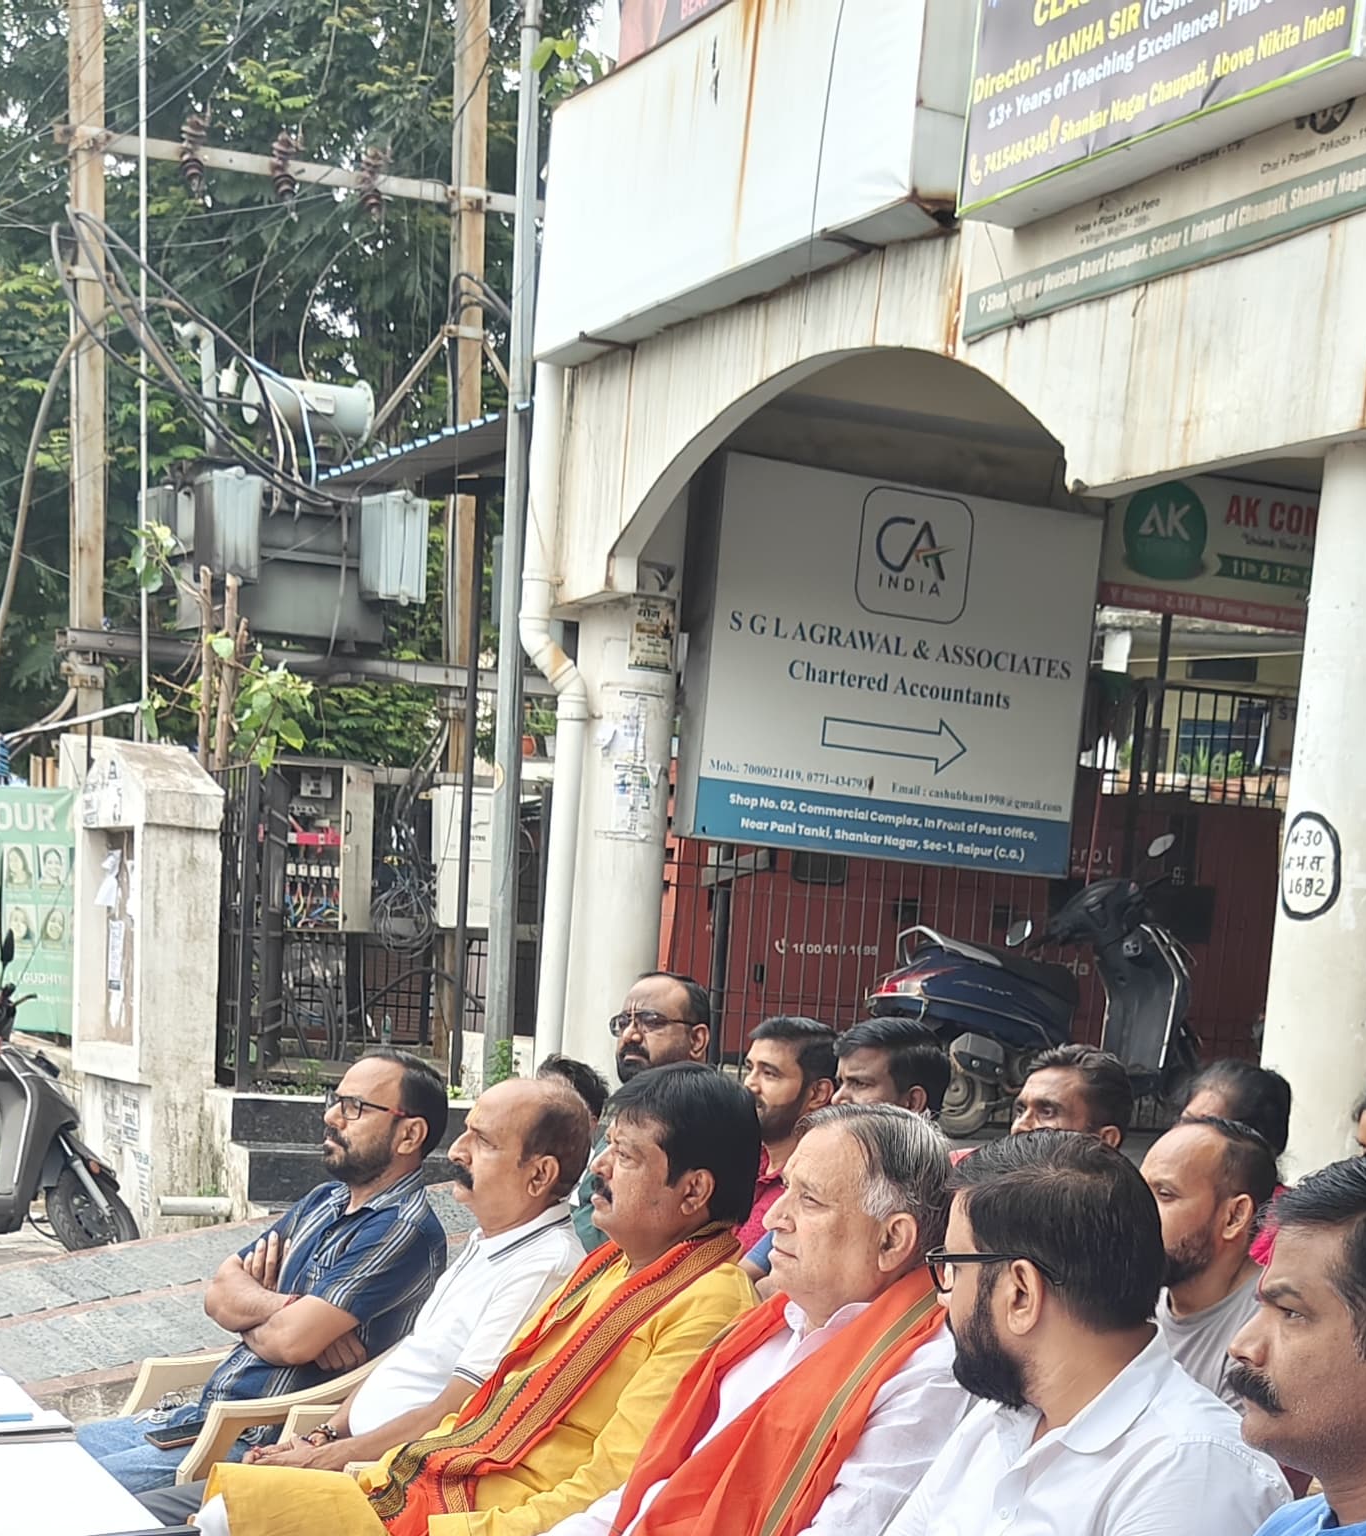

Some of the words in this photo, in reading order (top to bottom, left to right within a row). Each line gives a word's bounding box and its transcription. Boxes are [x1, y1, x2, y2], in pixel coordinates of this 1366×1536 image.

[973, 55, 1042, 104] Director:
[1045, 19, 1105, 71] KANHA
[1107, 2, 1142, 41] SIR
[987, 104, 1013, 131] 13+
[1015, 87, 1052, 118] Years
[1054, 73, 1071, 101] of
[1071, 46, 1136, 93] Teaching
[1137, 9, 1219, 62] Excellence
[1059, 108, 1110, 144] Shankar
[1110, 91, 1148, 125] Nagar
[1149, 58, 1209, 107] Chaupati,
[1211, 47, 1255, 81] Above
[1257, 22, 1300, 61] Nikita
[1302, 5, 1346, 42] Inden
[1290, 177, 1336, 209] Shankar
[1137, 501, 1191, 541] AK
[1224, 494, 1262, 529] AK
[875, 515, 947, 582] CA
[877, 573, 941, 598] INDIA
[729, 610, 744, 632] S
[749, 614, 768, 636] G
[774, 616, 788, 640] L
[791, 621, 909, 658] AGRAWAL
[913, 638, 932, 660] &
[935, 643, 1073, 681] ASSOCIATES
[787, 659, 890, 693] Chartered
[892, 675, 1012, 710] Accountants
[891, 782, 921, 797] Email
[729, 793, 759, 810] Shop
[759, 796, 779, 810] No.
[780, 797, 798, 813] 02,
[798, 801, 870, 821] Commercial
[869, 811, 924, 829] Complex,
[924, 816, 936, 829] In
[936, 817, 966, 832] Front
[966, 820, 979, 833] of
[979, 821, 1003, 837] Post
[1003, 825, 1038, 842] Office,
[740, 816, 769, 831] Near
[769, 820, 796, 834] Pani
[797, 823, 833, 841] Tanki,
[834, 828, 883, 845] Shankar
[883, 832, 922, 851] Nagar,
[922, 839, 956, 854] Sec-1,
[956, 841, 993, 859] Raipur
